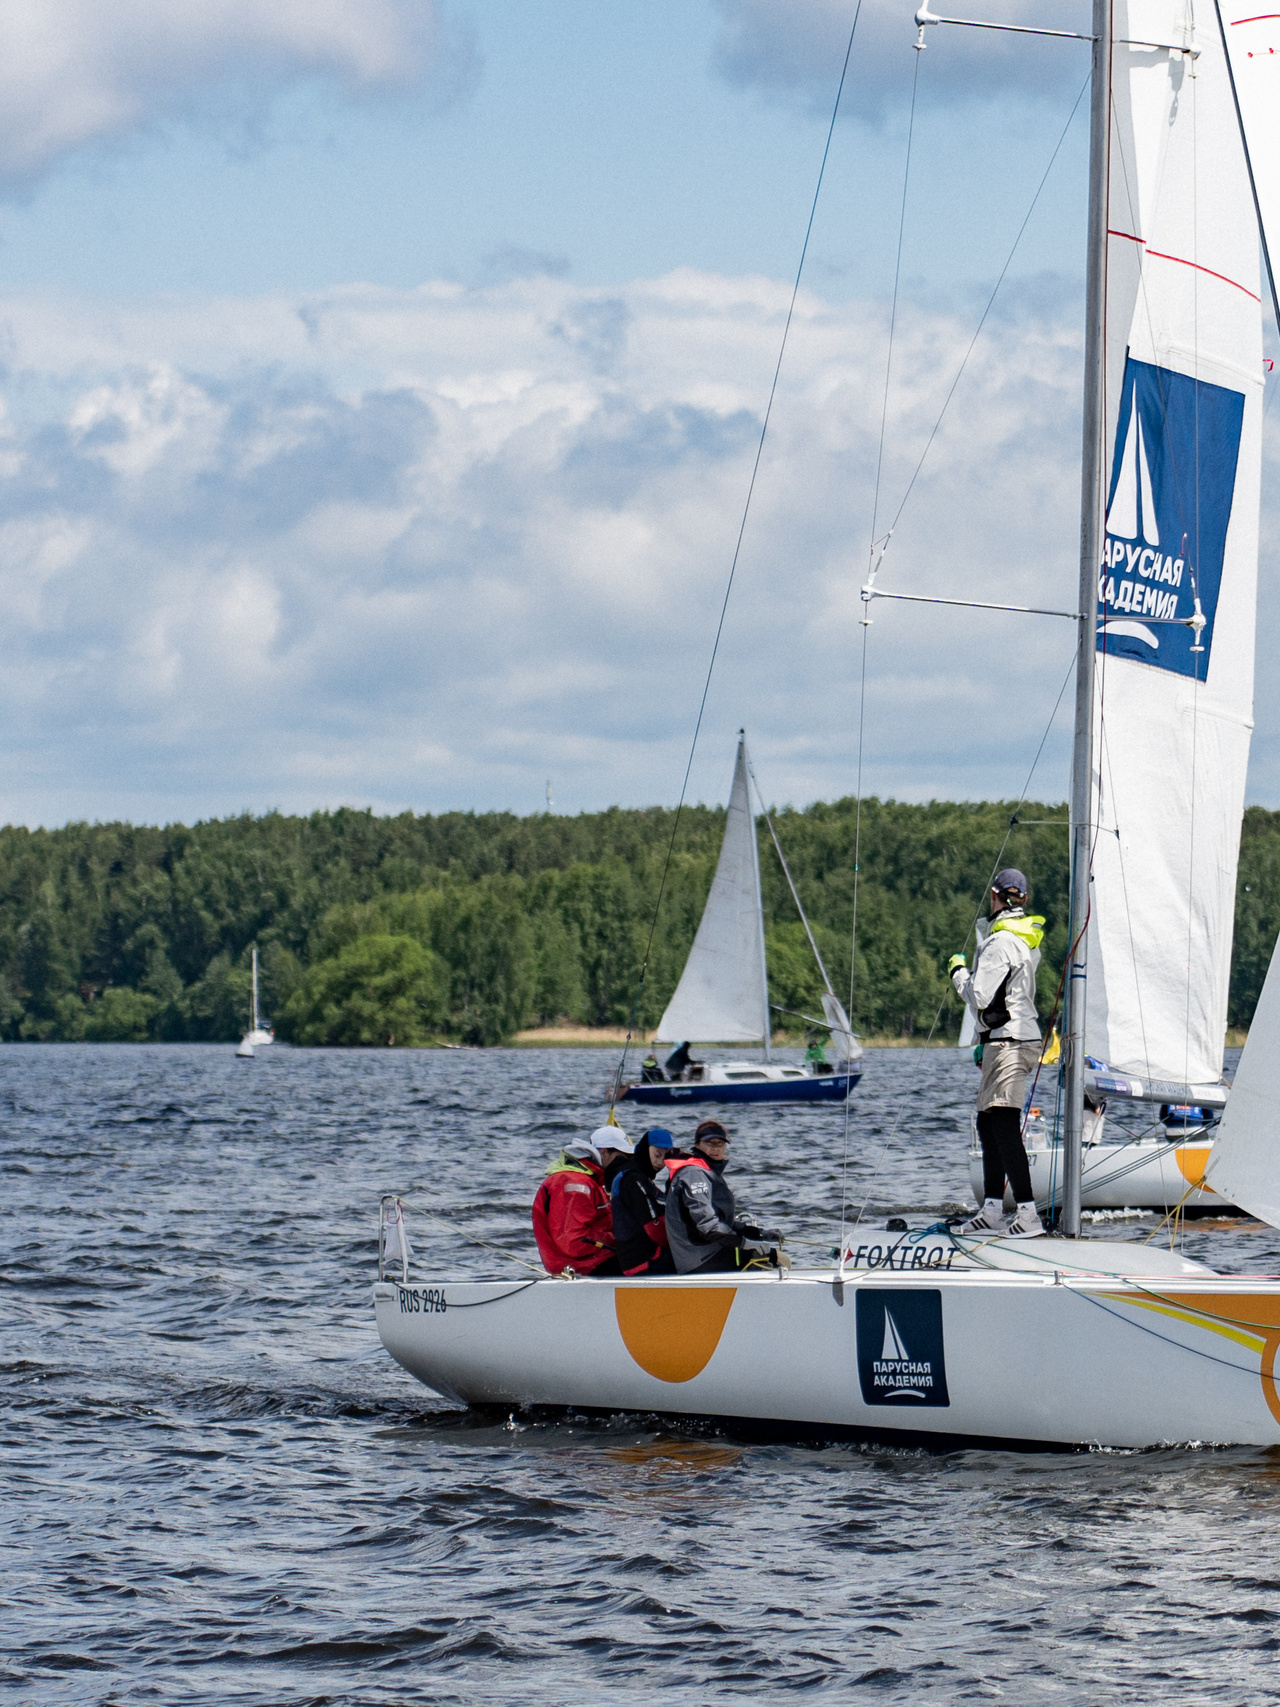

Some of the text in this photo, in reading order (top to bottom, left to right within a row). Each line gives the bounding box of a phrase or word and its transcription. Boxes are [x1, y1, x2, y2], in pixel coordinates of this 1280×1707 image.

[1100, 538, 1184, 587] АРУСНАЯ
[1098, 574, 1178, 619] КАДЕМИЯ
[853, 1245, 960, 1270] FOXTROT
[400, 1289, 420, 1313] RUS
[873, 1362, 931, 1374] ПАРУСНАЯ
[874, 1375, 933, 1387] АКАДЕМИЯ
